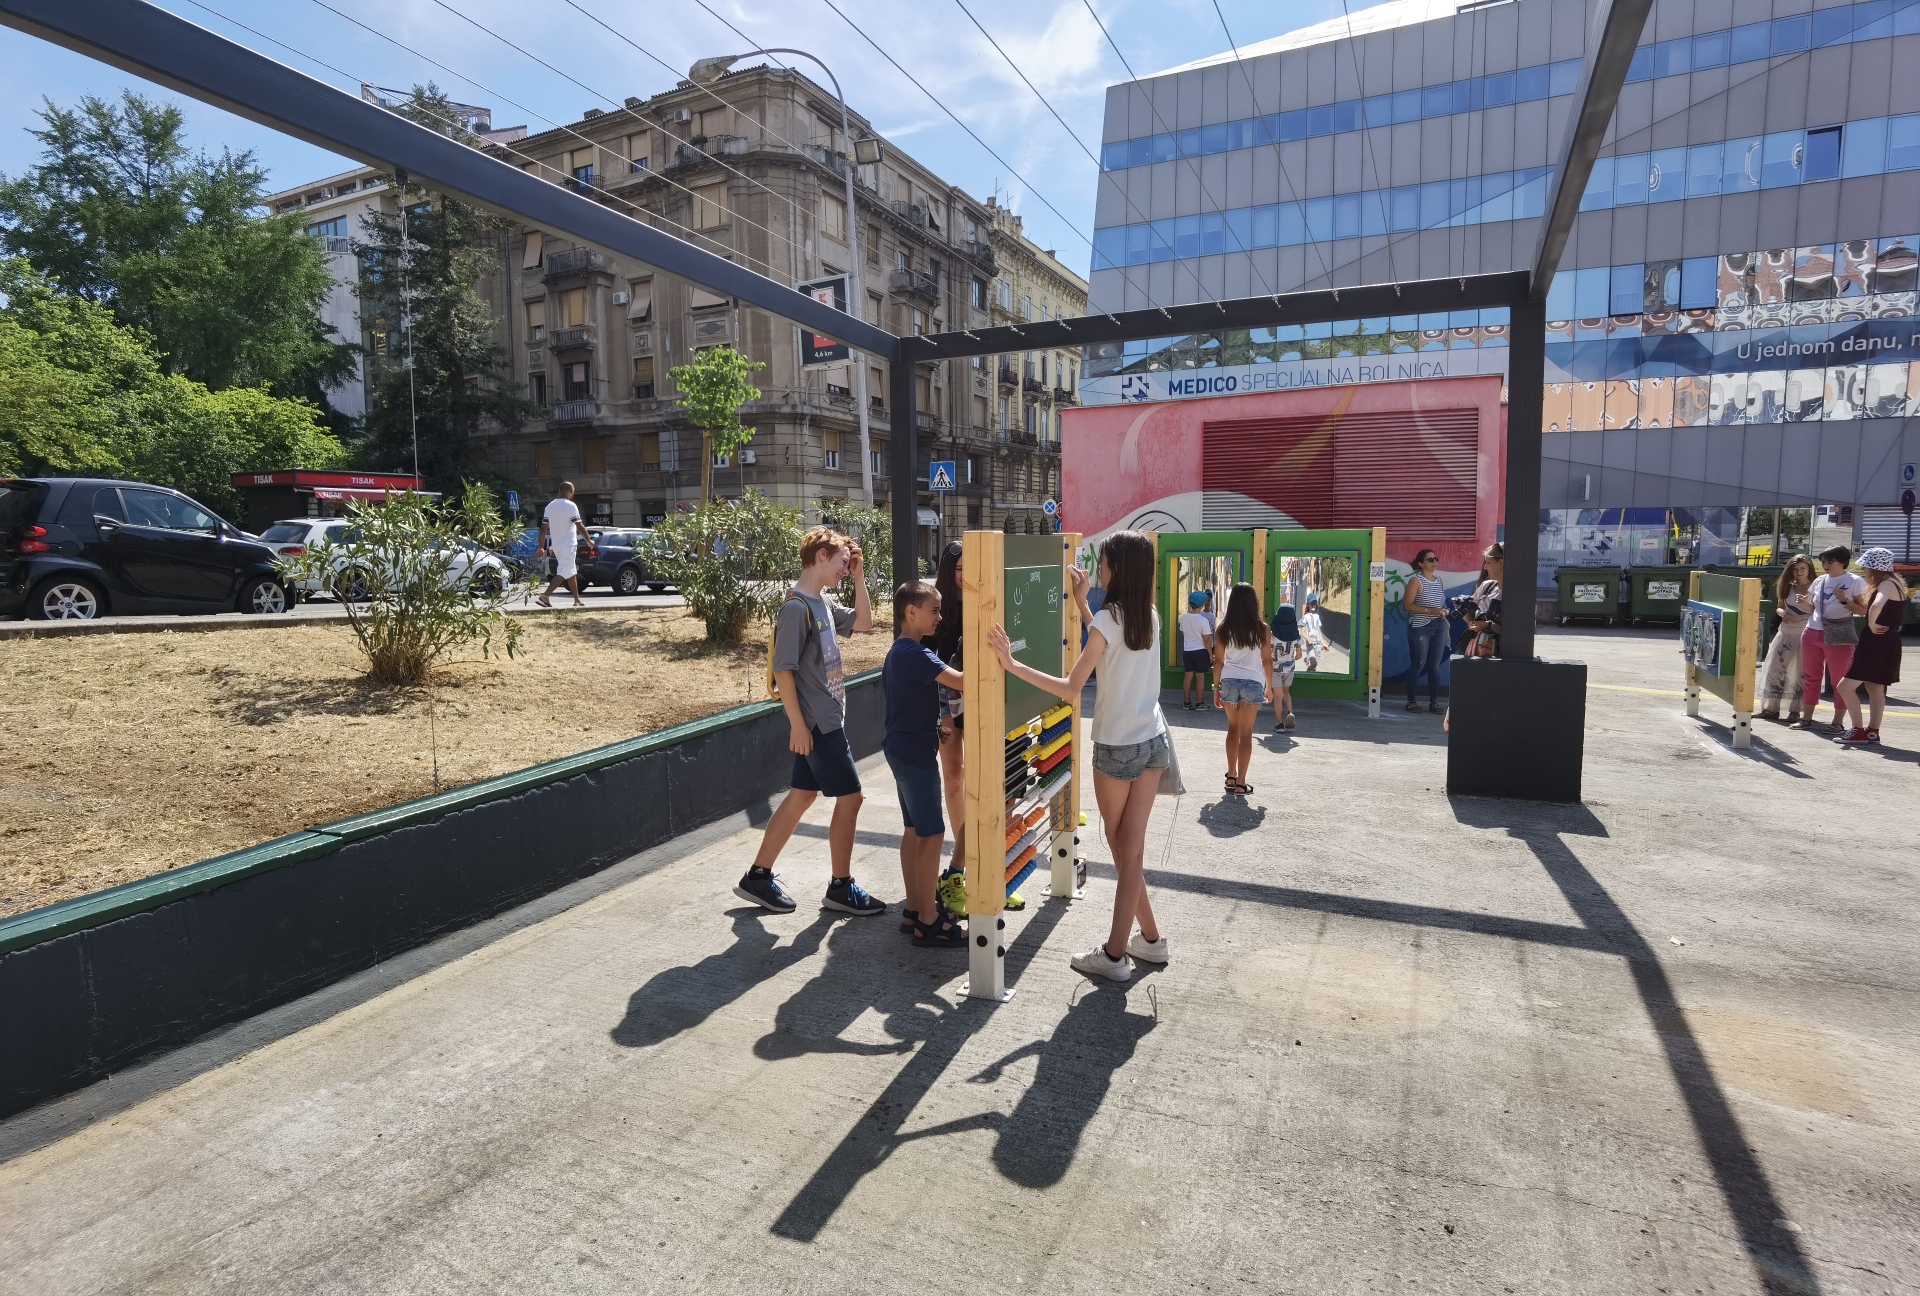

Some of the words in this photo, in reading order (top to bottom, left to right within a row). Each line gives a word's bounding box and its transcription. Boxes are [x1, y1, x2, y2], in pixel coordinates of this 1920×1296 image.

[1737, 343, 1750, 359] U
[1755, 341, 1835, 362] jednom
[1841, 335, 1903, 351] danu,
[1168, 376, 1237, 396] MEDICO
[1241, 367, 1353, 390] SPECIJALNA
[254, 474, 273, 484] TISAK
[351, 477, 375, 485] TISAK
